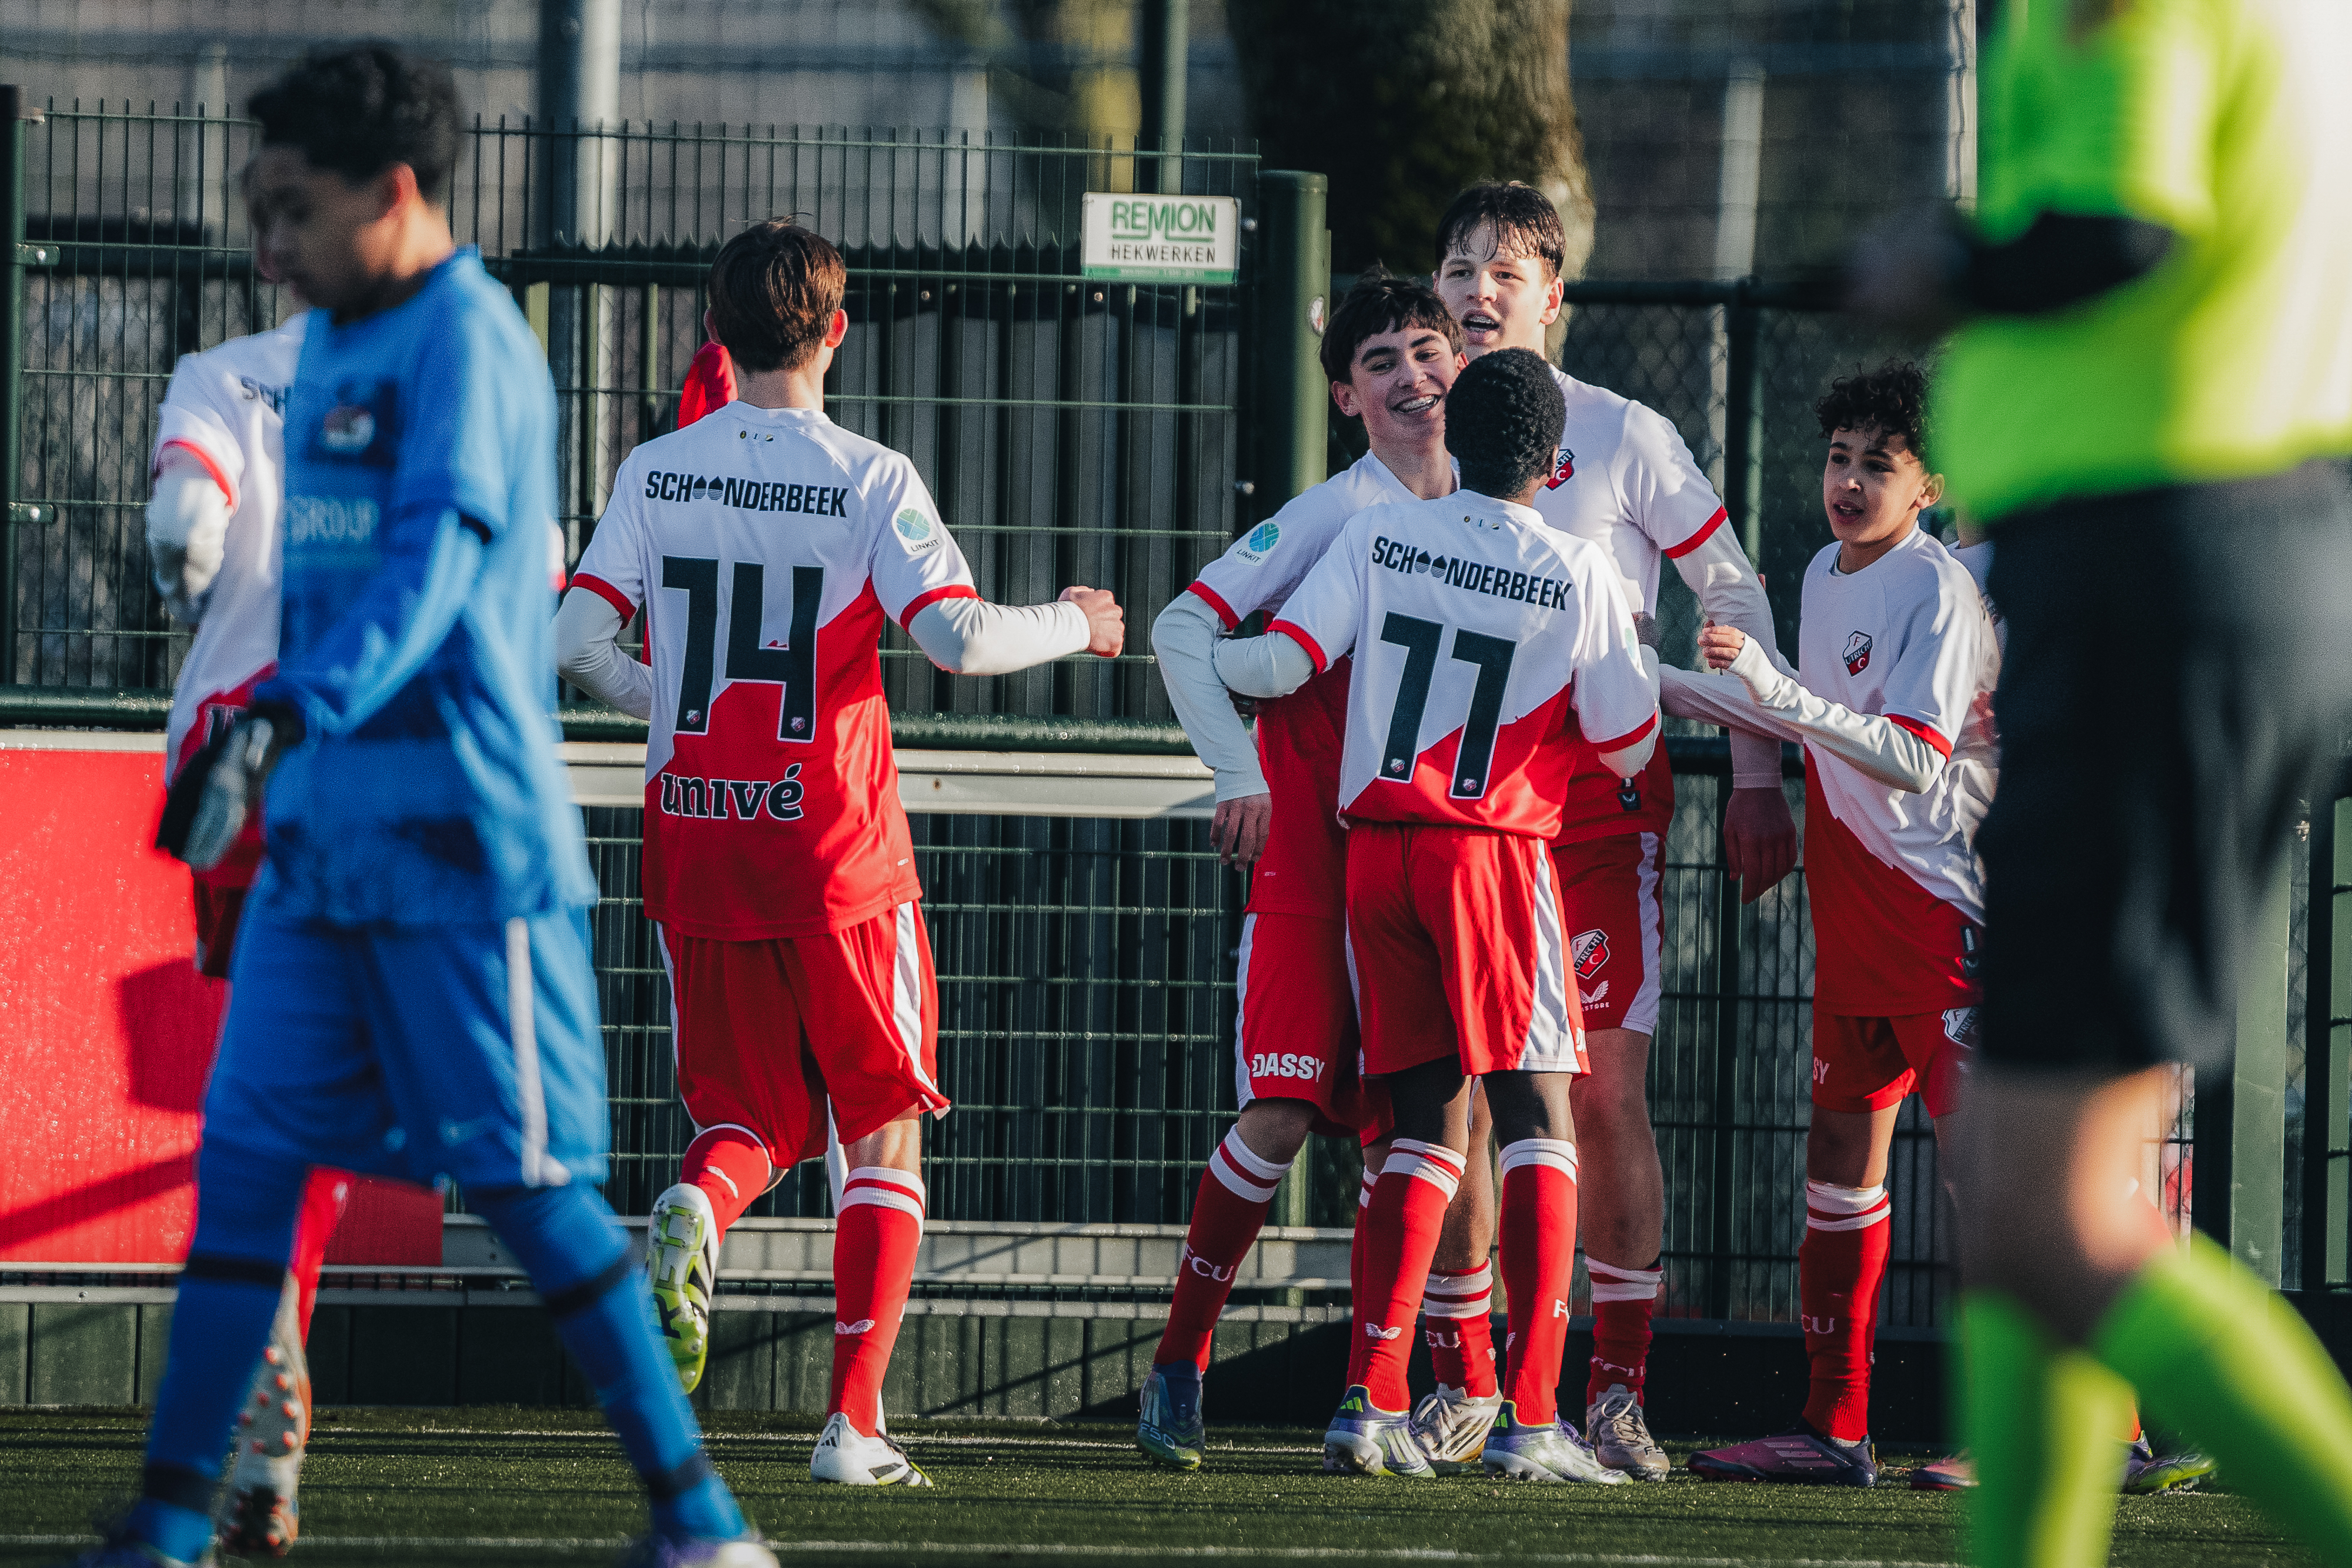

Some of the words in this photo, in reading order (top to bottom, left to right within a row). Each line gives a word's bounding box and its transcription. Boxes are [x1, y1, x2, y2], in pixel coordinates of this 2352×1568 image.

[1111, 200, 1216, 237] REMION
[1111, 243, 1216, 263] HEKWERKEN
[910, 539, 939, 551] LINKIT
[1237, 549, 1261, 563] LINKIT
[662, 555, 824, 743] 14
[1845, 640, 1872, 664] UTRECHT
[1853, 636, 1860, 646] F
[1857, 657, 1866, 668] C
[660, 763, 805, 820] univé
[1574, 934, 1603, 971] UTRECHT
[1581, 1002, 1610, 1012] STORE
[1252, 1052, 1325, 1083] DASSY
[1184, 1243, 1234, 1282] FCU
